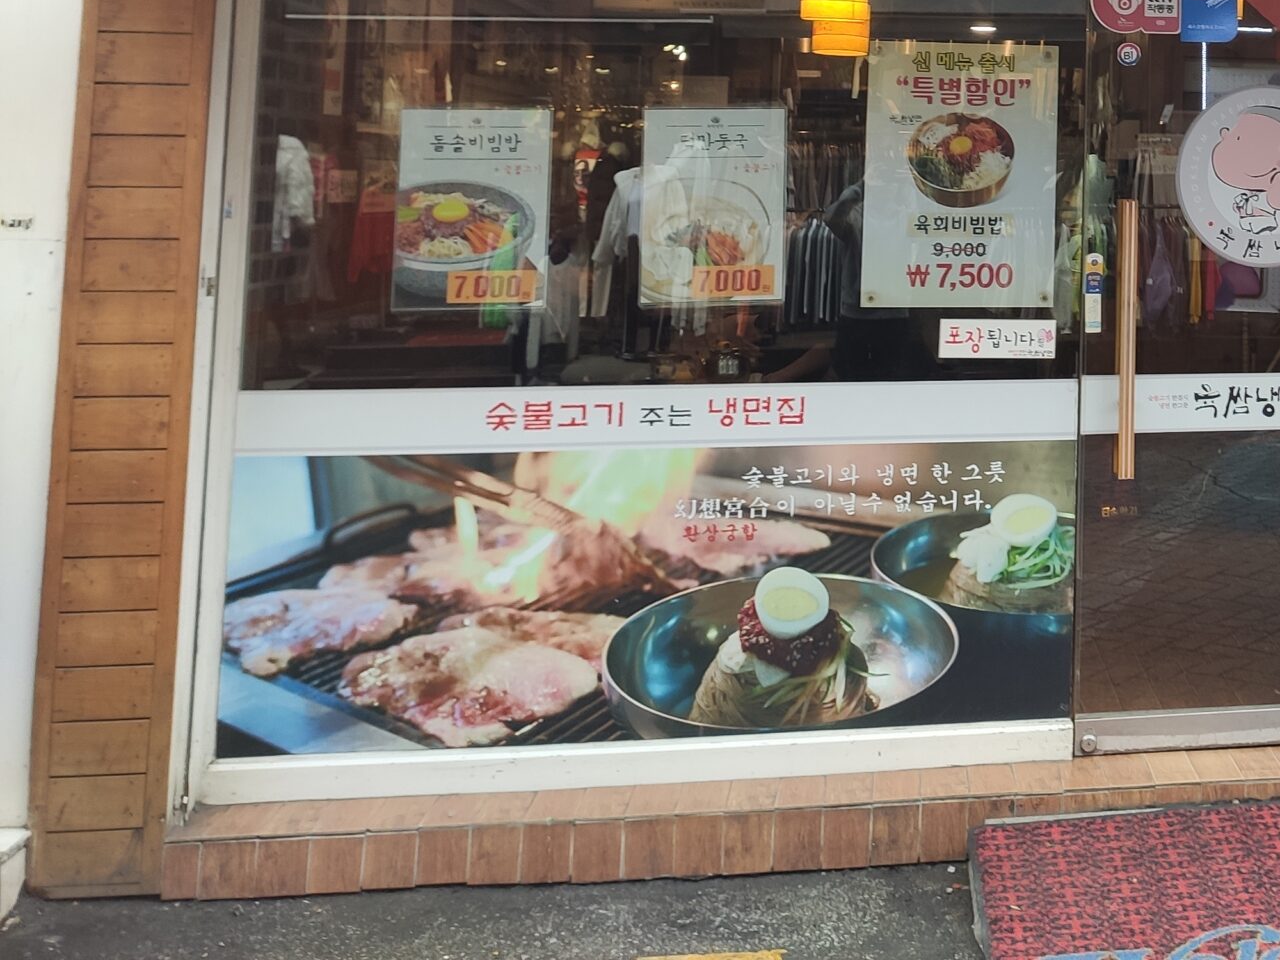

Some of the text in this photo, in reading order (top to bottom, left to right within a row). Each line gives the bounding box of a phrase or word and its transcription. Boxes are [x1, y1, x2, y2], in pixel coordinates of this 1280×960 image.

[913, 51, 1015, 74] 신 메뉴 출시
[914, 215, 1005, 236] 육회비빔밥
[945, 327, 1035, 353] 포장됩니다
[486, 396, 805, 431] 숯불고기 주는 냉면집
[741, 460, 1006, 489] 숯불고기와 냉면 한 그릇
[814, 493, 883, 515] 아닐수
[893, 490, 993, 513] 없습니다.
[682, 523, 758, 542] 환상궁합
